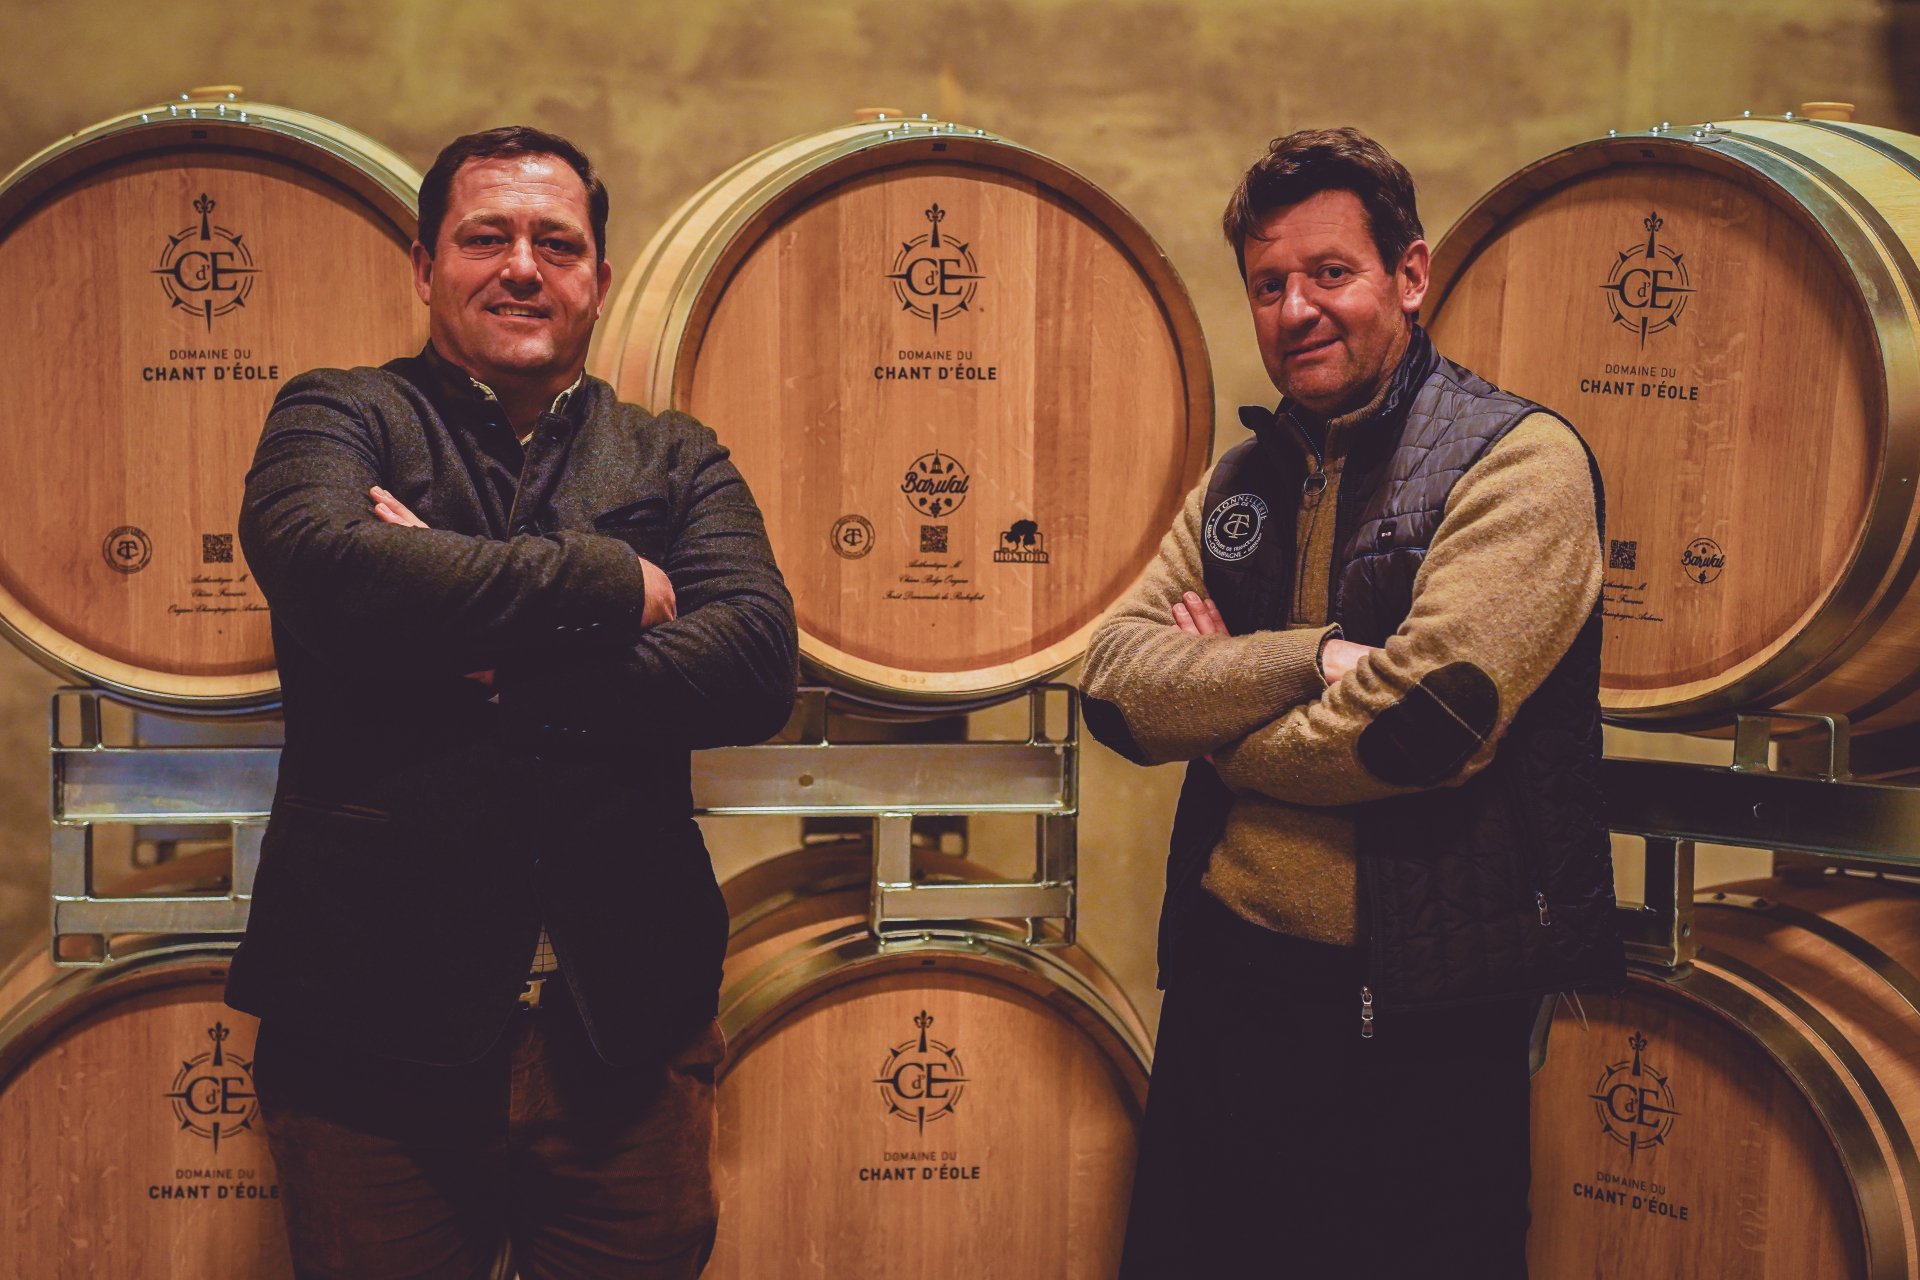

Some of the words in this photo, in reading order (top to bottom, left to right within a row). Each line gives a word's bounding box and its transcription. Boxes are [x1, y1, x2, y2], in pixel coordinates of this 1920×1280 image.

[169, 349, 228, 360] DOMAINE
[234, 349, 251, 359] DU
[899, 350, 952, 360] DOMAINE
[957, 350, 973, 360] DU
[143, 366, 206, 381] CHANT
[214, 362, 279, 381] D'ÉOLE
[874, 366, 932, 380] CHANT
[939, 363, 997, 380] D'ÉOLE
[1605, 363, 1656, 377] DOMAINE
[1661, 368, 1676, 378] DU
[1580, 379, 1635, 396] CHANT
[1641, 381, 1699, 401] D'ÉOLE
[1217, 495, 1268, 520] TONNELLERIE
[1210, 542, 1242, 559] CHAMPAGNE
[884, 1152, 936, 1162] DOMAINE
[941, 1151, 956, 1161] DU
[176, 1169, 233, 1180] DOMAINE
[238, 1169, 255, 1179] DU
[859, 1168, 916, 1181] CHANT
[922, 1163, 980, 1180] D'ÉOLE
[1597, 1171, 1646, 1190] DOMAINE
[1651, 1183, 1666, 1195] DU
[148, 1185, 210, 1199] CHANT
[1573, 1183, 1626, 1206] CHANT
[1632, 1196, 1689, 1221] D'ÉOLE
